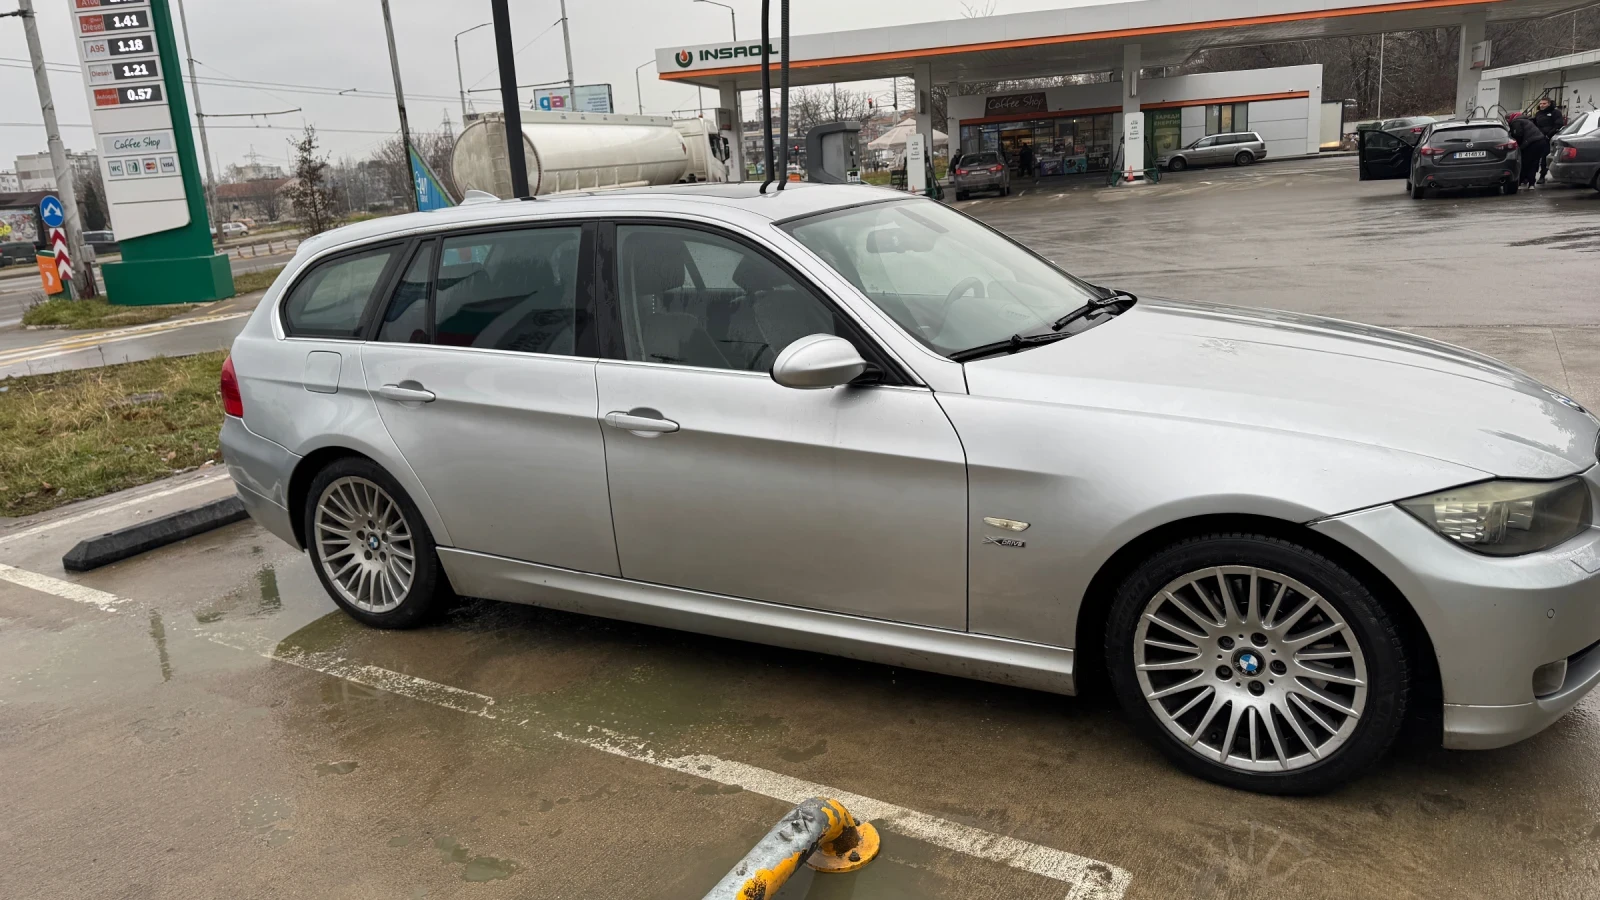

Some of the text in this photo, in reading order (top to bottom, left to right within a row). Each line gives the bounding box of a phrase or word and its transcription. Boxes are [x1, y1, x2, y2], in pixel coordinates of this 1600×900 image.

[82, 23, 104, 31] Diesel
[113, 14, 139, 28] 1.41
[90, 44, 105, 53] A95
[118, 39, 144, 52] 1.18
[699, 44, 779, 61] INSAOL
[122, 64, 149, 77] 1.21
[127, 88, 152, 101] 0.57
[988, 95, 1044, 110] Coffee Shop
[114, 137, 160, 150] Coffee Shop
